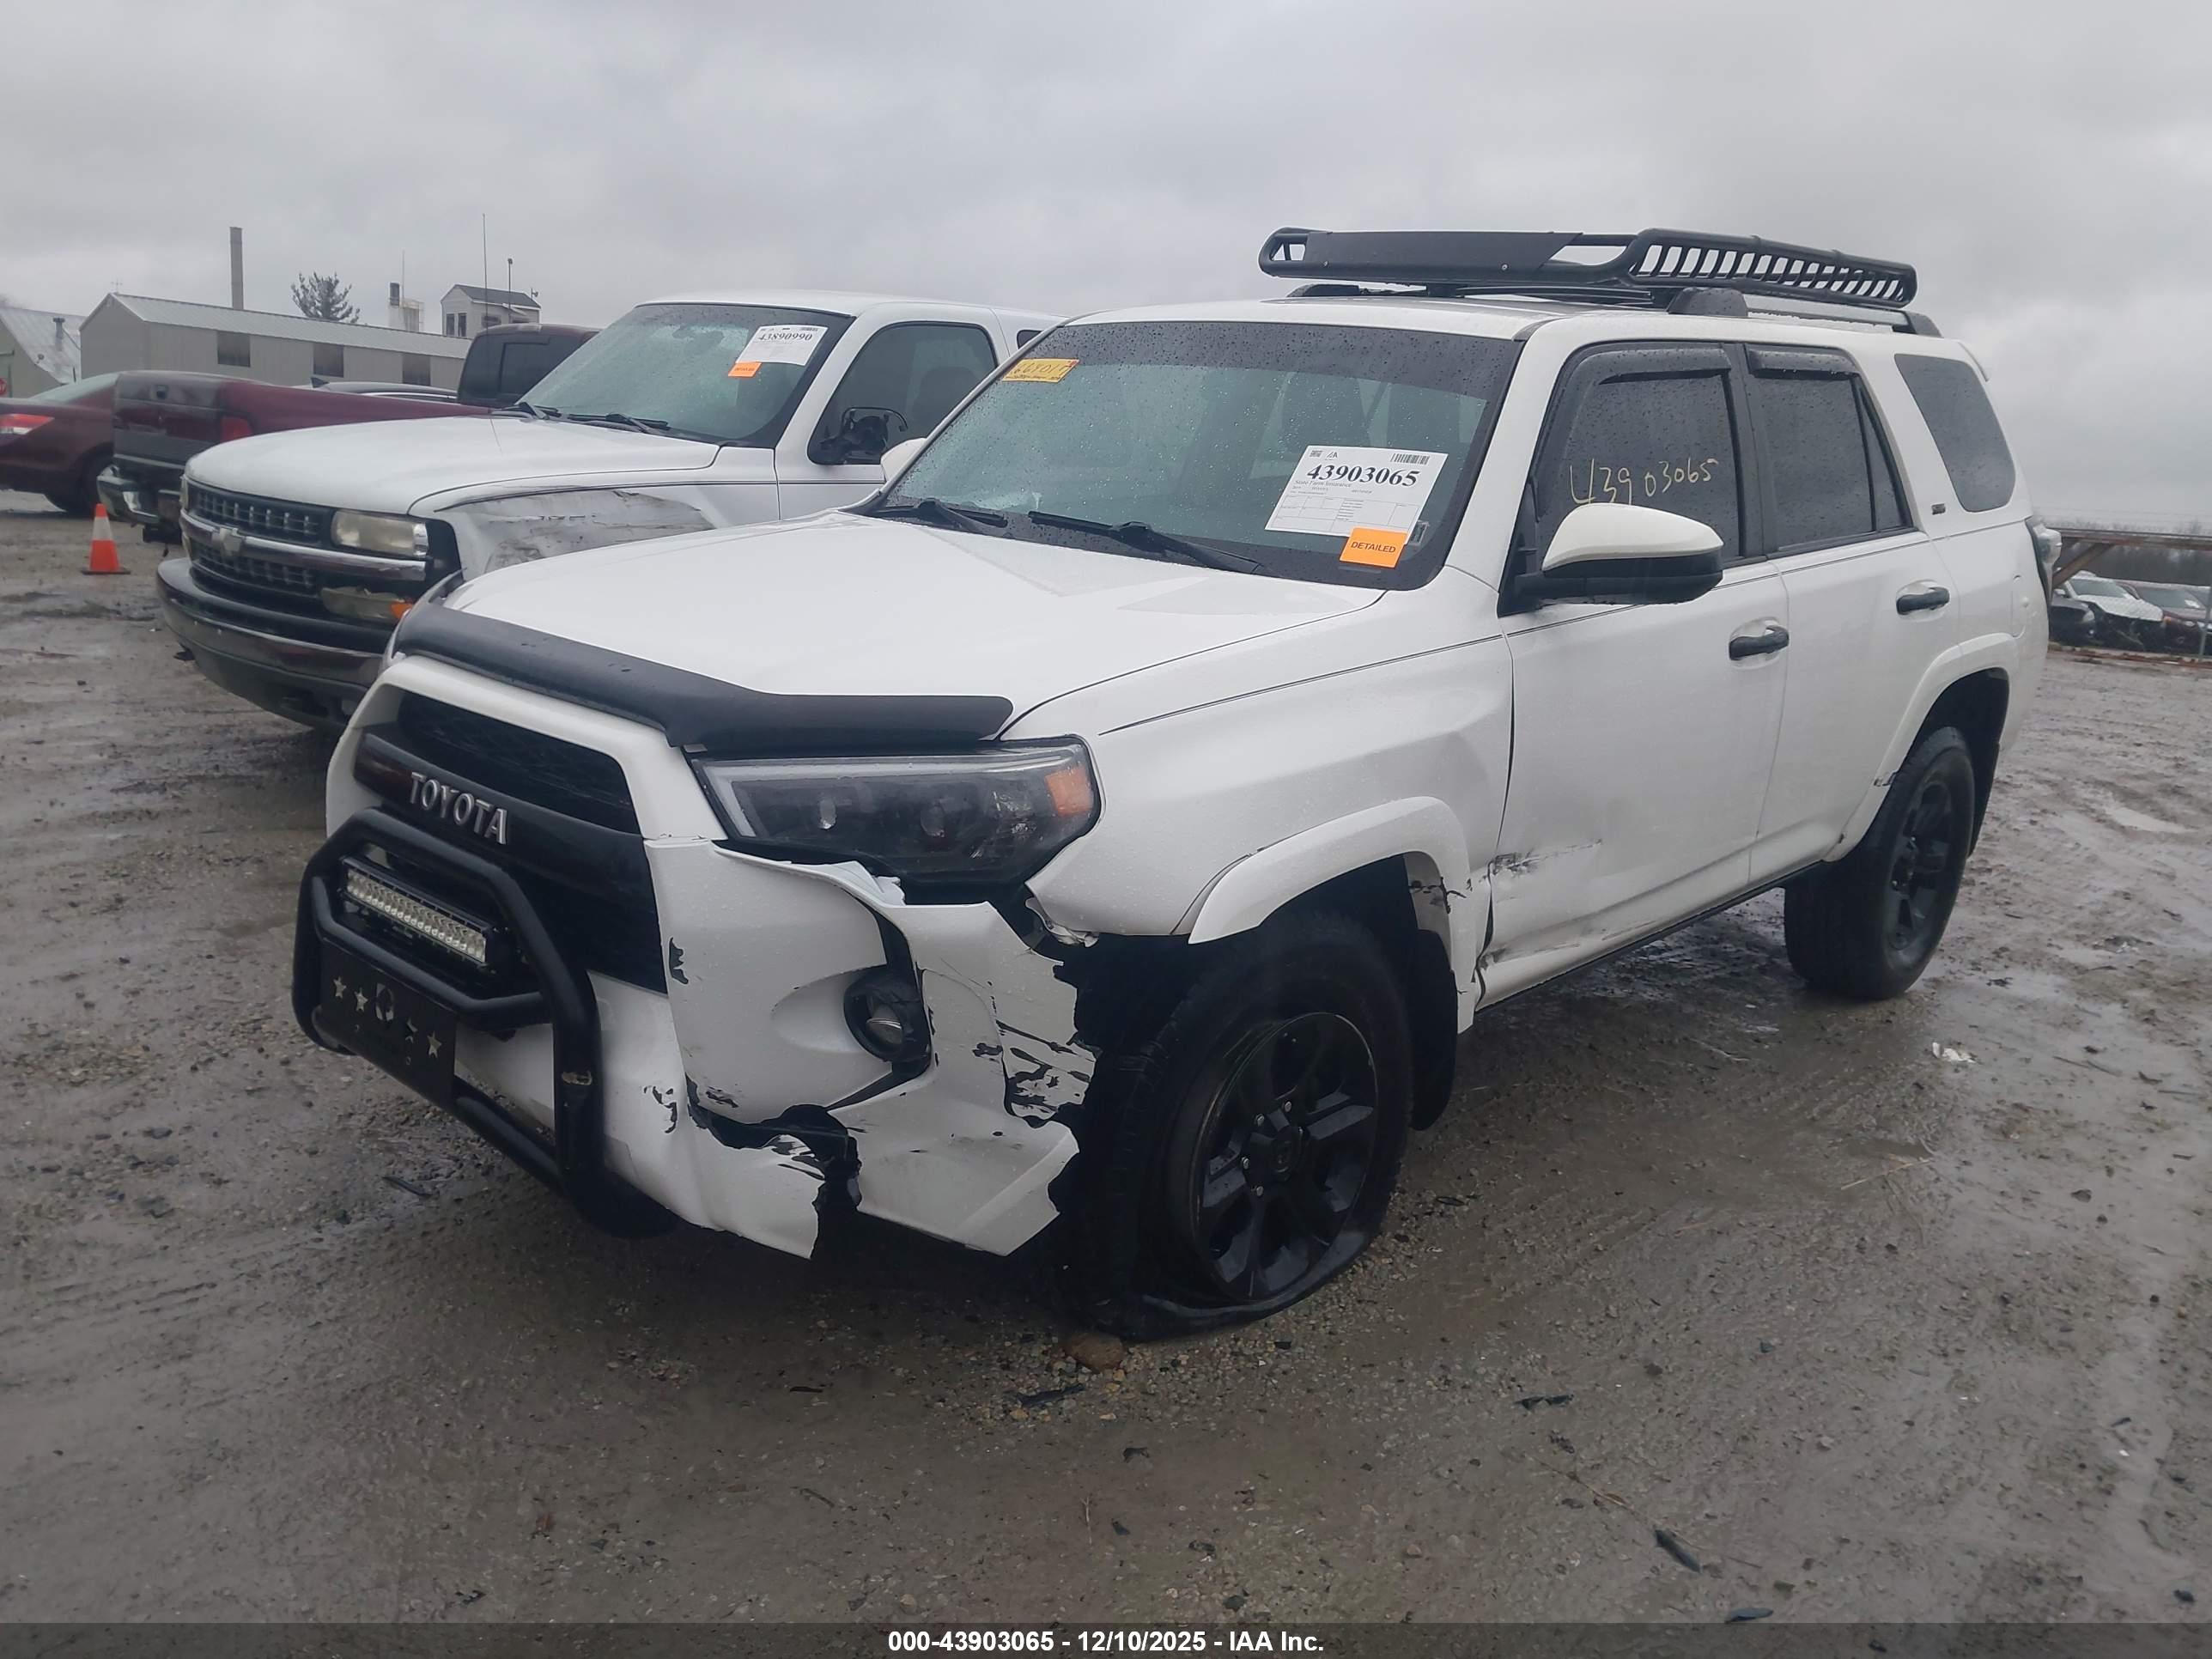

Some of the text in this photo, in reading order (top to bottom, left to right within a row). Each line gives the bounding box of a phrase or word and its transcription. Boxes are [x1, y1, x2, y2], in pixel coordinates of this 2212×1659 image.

[758, 331, 812, 341] 43890990
[1306, 464, 1419, 487] 43903065
[1350, 541, 1396, 553] DETAILED
[410, 771, 507, 845] TOYOTA
